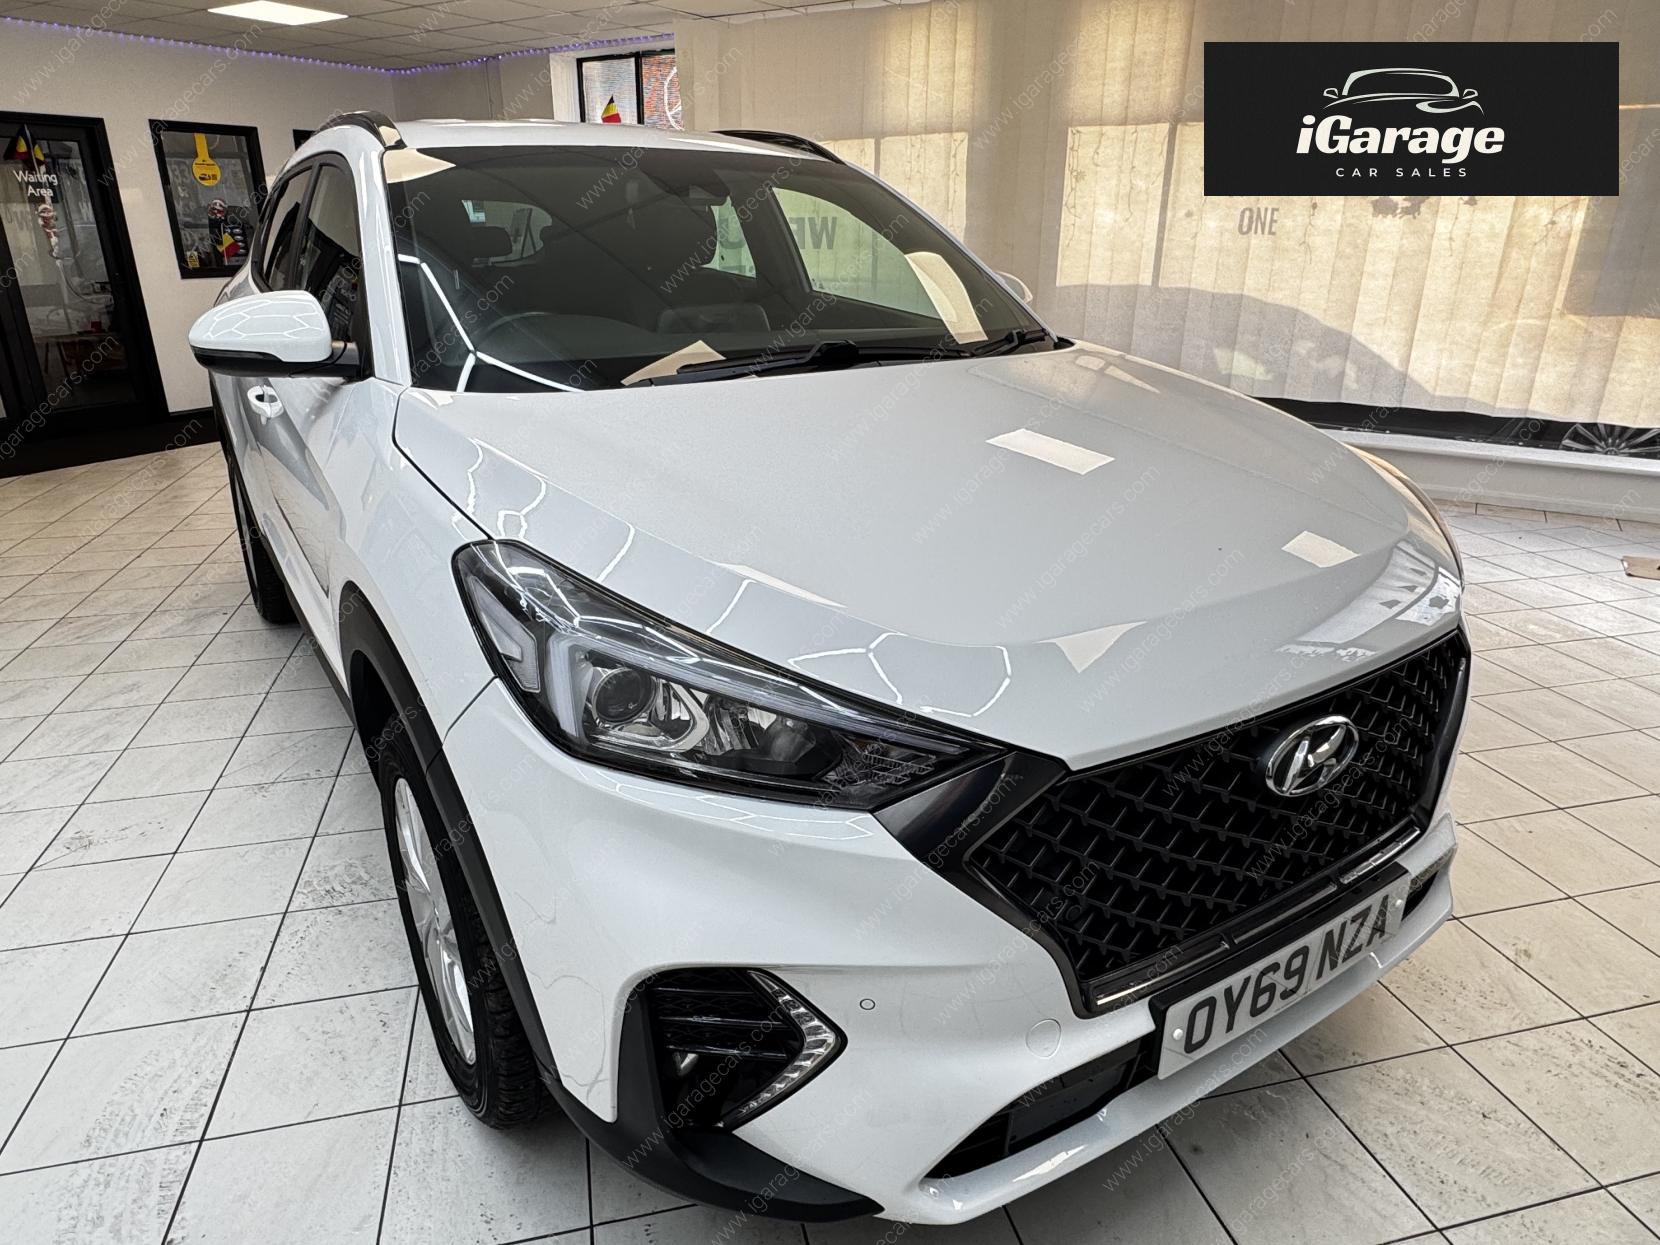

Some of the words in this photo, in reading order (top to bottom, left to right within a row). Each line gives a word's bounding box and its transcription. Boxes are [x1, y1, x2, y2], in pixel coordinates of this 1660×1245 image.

[12, 169, 58, 186] Waiting
[27, 185, 54, 197] Area
[1237, 206, 1280, 236] ONE
[1184, 944, 1310, 1054] OY69
[1316, 894, 1389, 981] NZA
